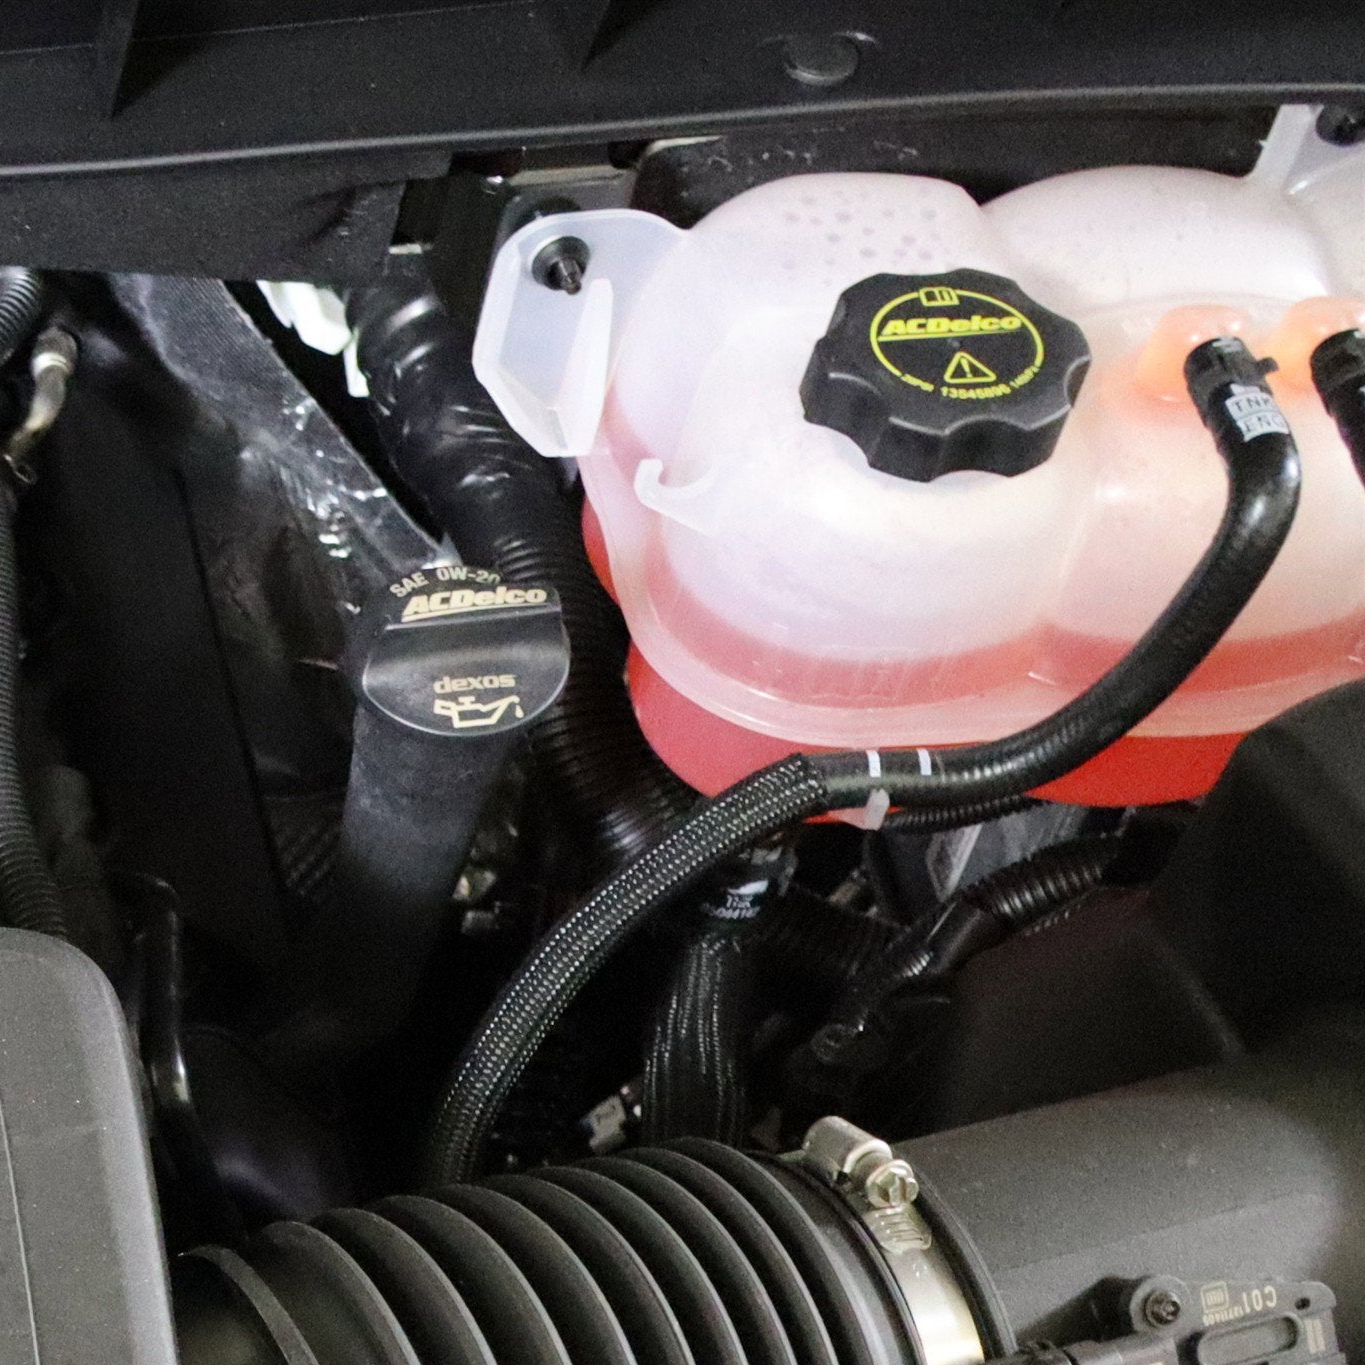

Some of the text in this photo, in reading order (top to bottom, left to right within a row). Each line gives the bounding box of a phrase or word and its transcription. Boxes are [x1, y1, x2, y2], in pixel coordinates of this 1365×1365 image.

[881, 315, 1023, 336] ACDelco
[390, 571, 429, 598] SAE
[402, 586, 547, 616] ACDelco
[434, 674, 517, 694] dexos
